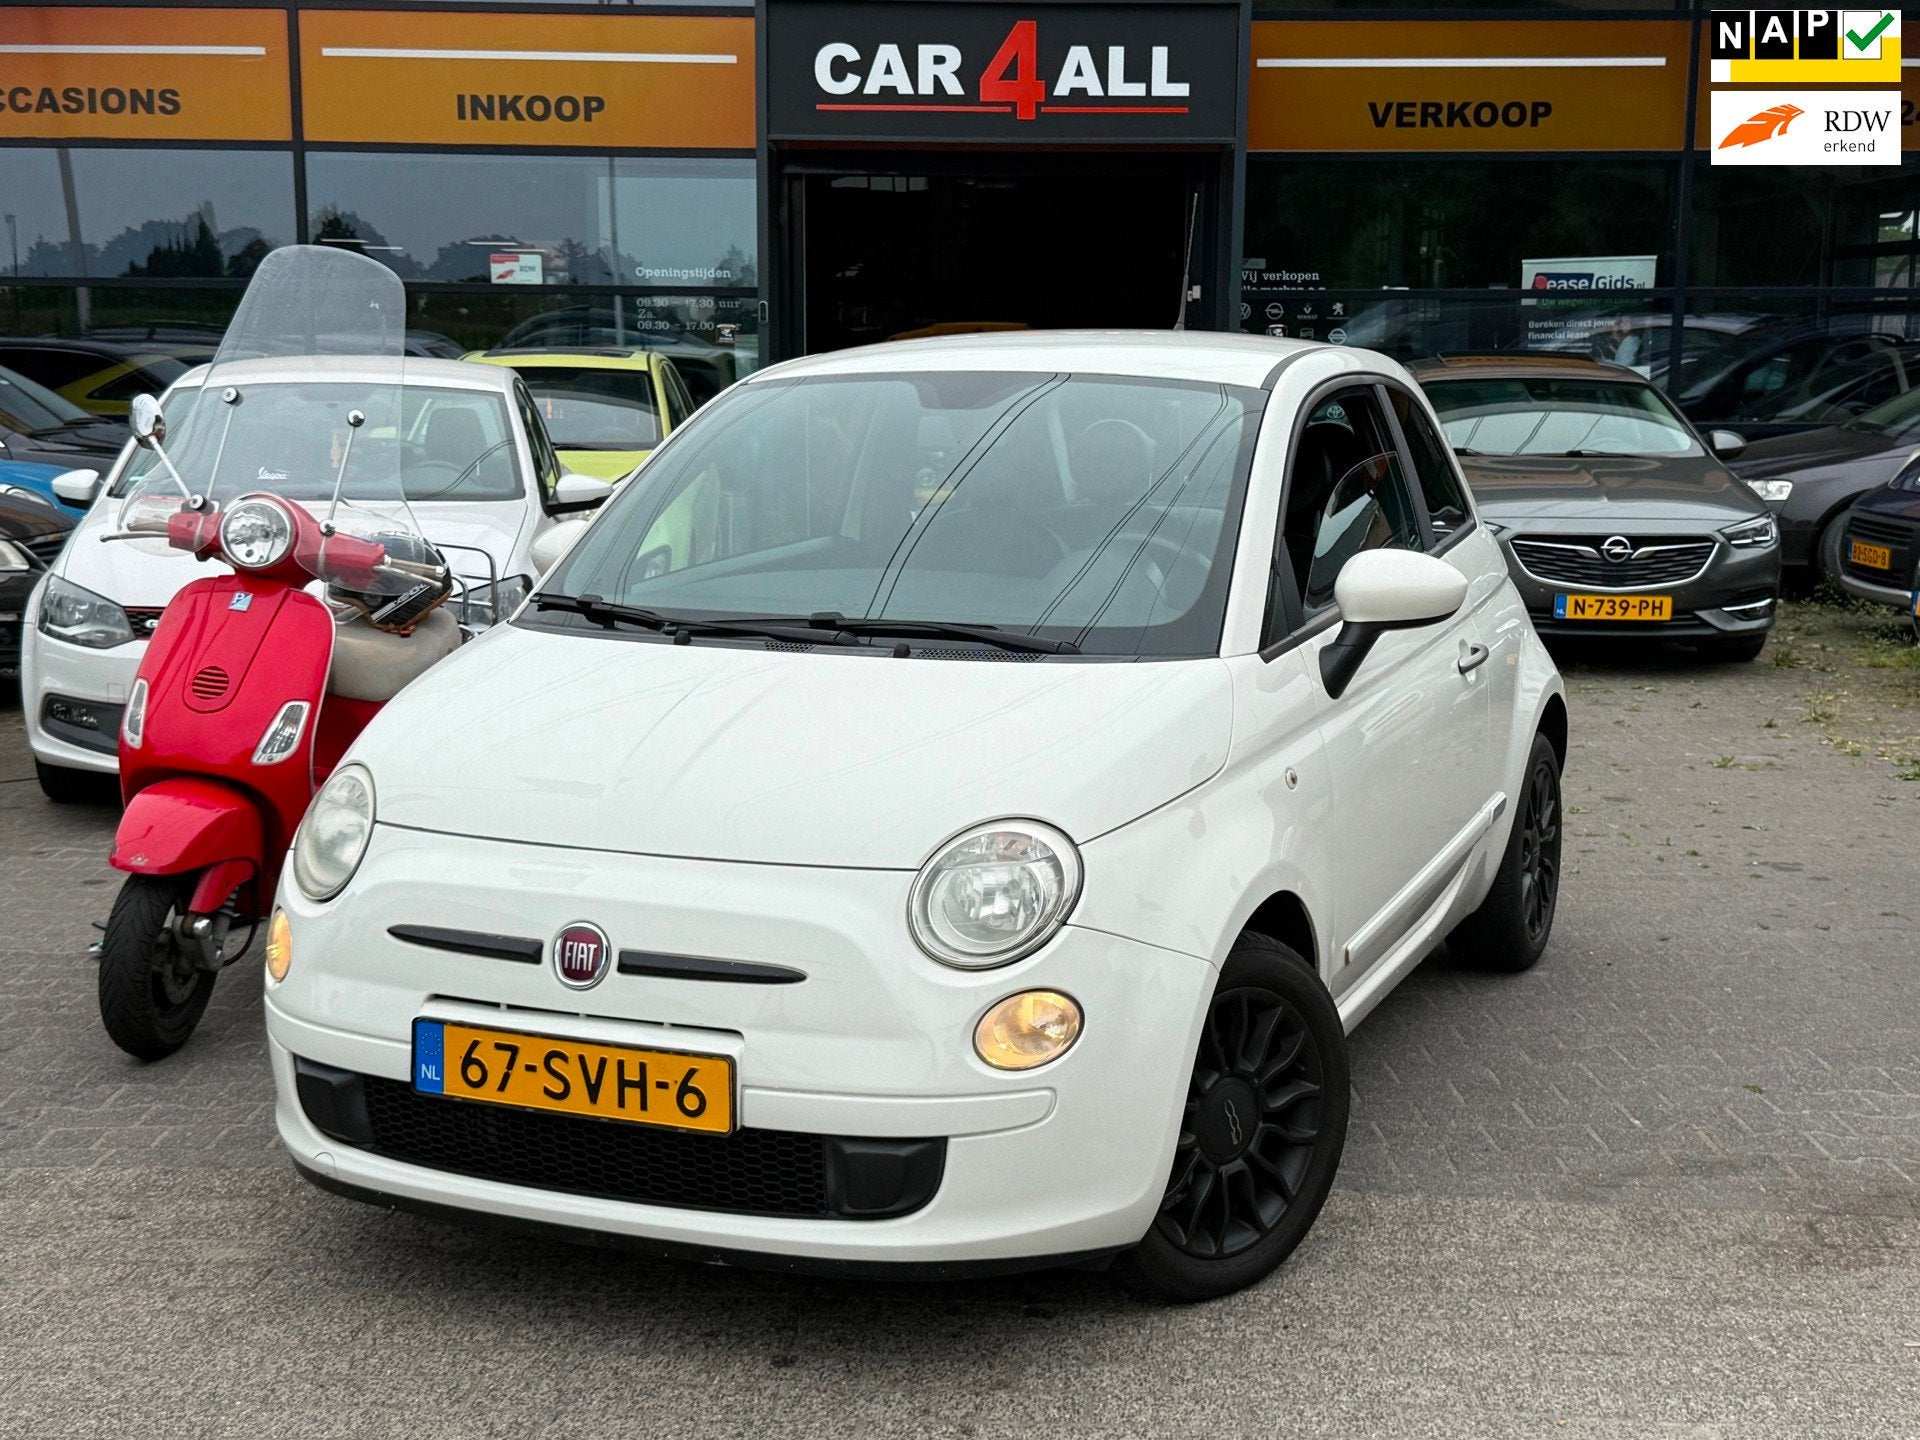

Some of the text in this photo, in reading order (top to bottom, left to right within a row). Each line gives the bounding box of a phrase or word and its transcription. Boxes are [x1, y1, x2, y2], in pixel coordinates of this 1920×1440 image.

[814, 20, 1190, 120] CAR 4 ALL
[0, 87, 181, 116] CASIONS
[456, 94, 606, 122] INKOOP
[1368, 101, 1553, 128] VERKOOP
[635, 266, 732, 280] Openingstijden
[1262, 270, 1320, 283] verkopen
[638, 309, 657, 319] Za.
[685, 321, 715, 331] 17.00
[1528, 320, 1565, 329] Bereken
[1566, 319, 1592, 328] direct
[1527, 331, 1590, 340] financial lease
[1573, 598, 1664, 617] N-739-PH
[564, 940, 599, 972] FIAT
[421, 1039, 707, 1119] NL 67-SVH-6
